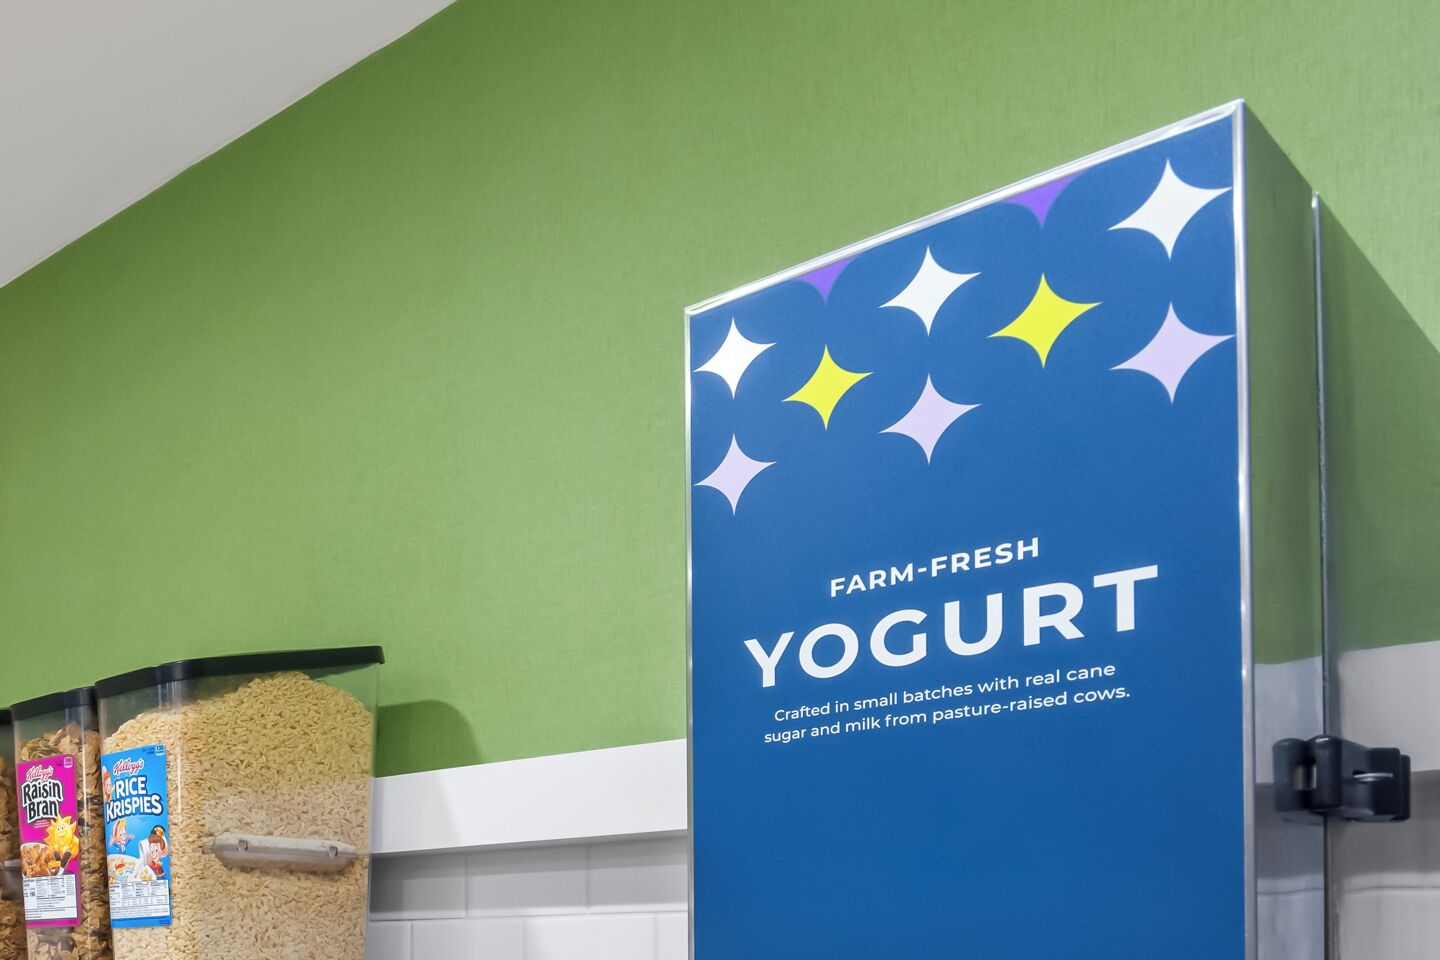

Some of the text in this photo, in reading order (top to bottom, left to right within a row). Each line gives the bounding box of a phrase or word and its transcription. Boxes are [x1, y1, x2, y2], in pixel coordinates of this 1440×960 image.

[830, 536, 1040, 598] FARM-FRESH
[744, 565, 1158, 689] YOGURT
[774, 664, 1116, 722] Crafted in small batches with real cane
[764, 686, 1131, 744] sugar and milk from pasture-raised cows.
[113, 758, 144, 775] Kellogg's
[23, 780, 63, 804] Raisin
[115, 776, 147, 798] RICE
[27, 800, 59, 822] Bran
[106, 793, 163, 823] KRISPIES
